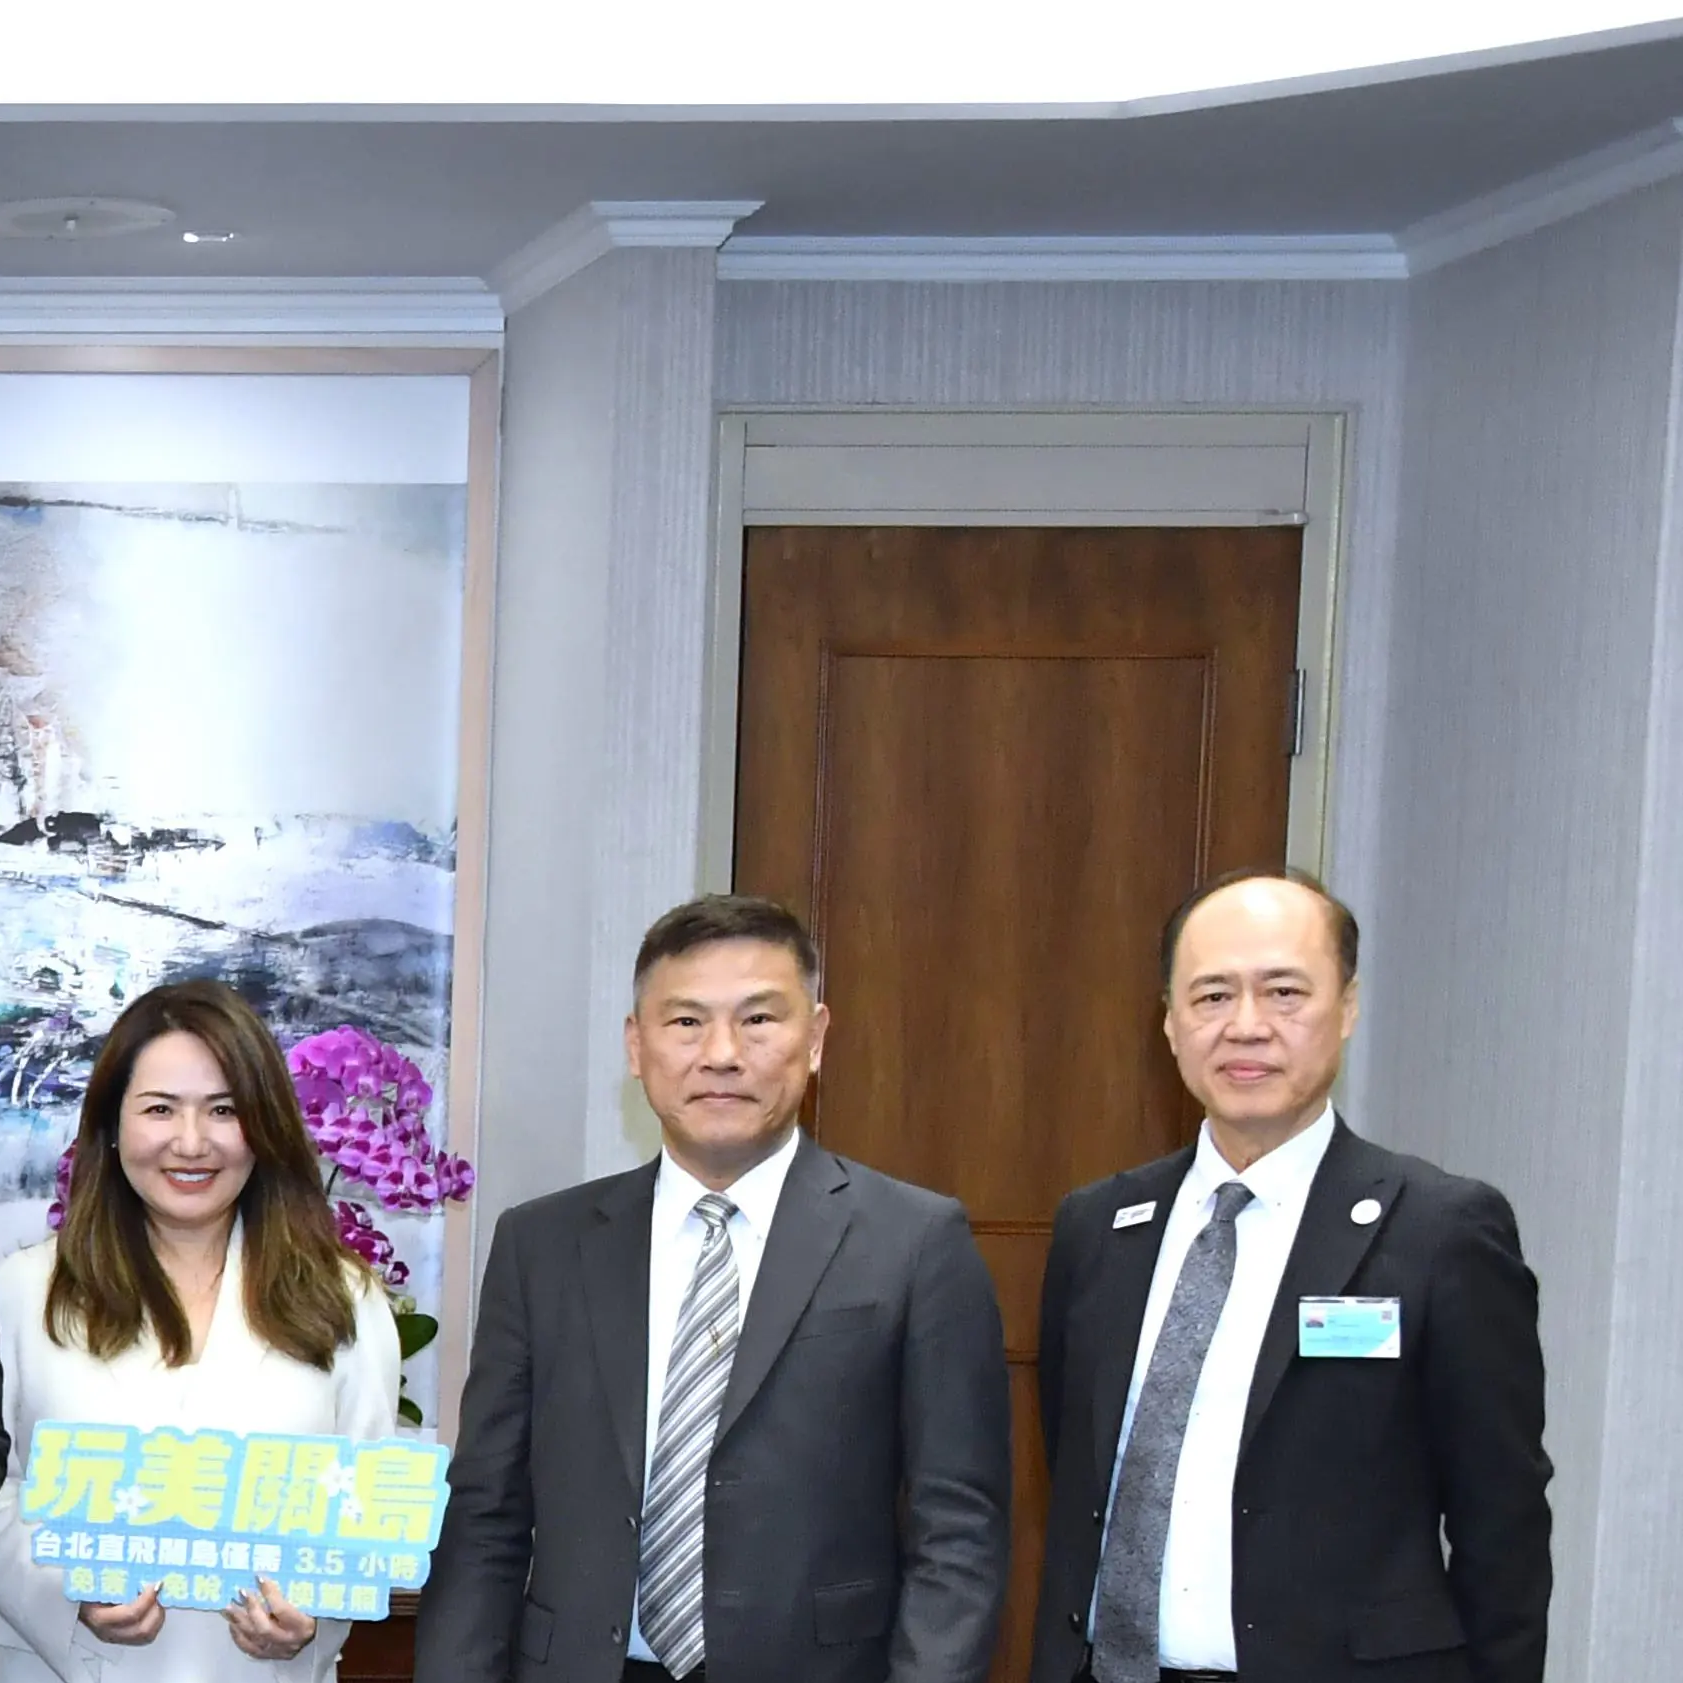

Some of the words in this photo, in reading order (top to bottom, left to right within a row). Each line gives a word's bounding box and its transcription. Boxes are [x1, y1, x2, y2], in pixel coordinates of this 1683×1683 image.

[27, 1429, 436, 1542] 玩美關島
[35, 1530, 283, 1574] 台北直飛關島僅需
[295, 1545, 345, 1576] 3.5
[358, 1550, 419, 1582] 小時
